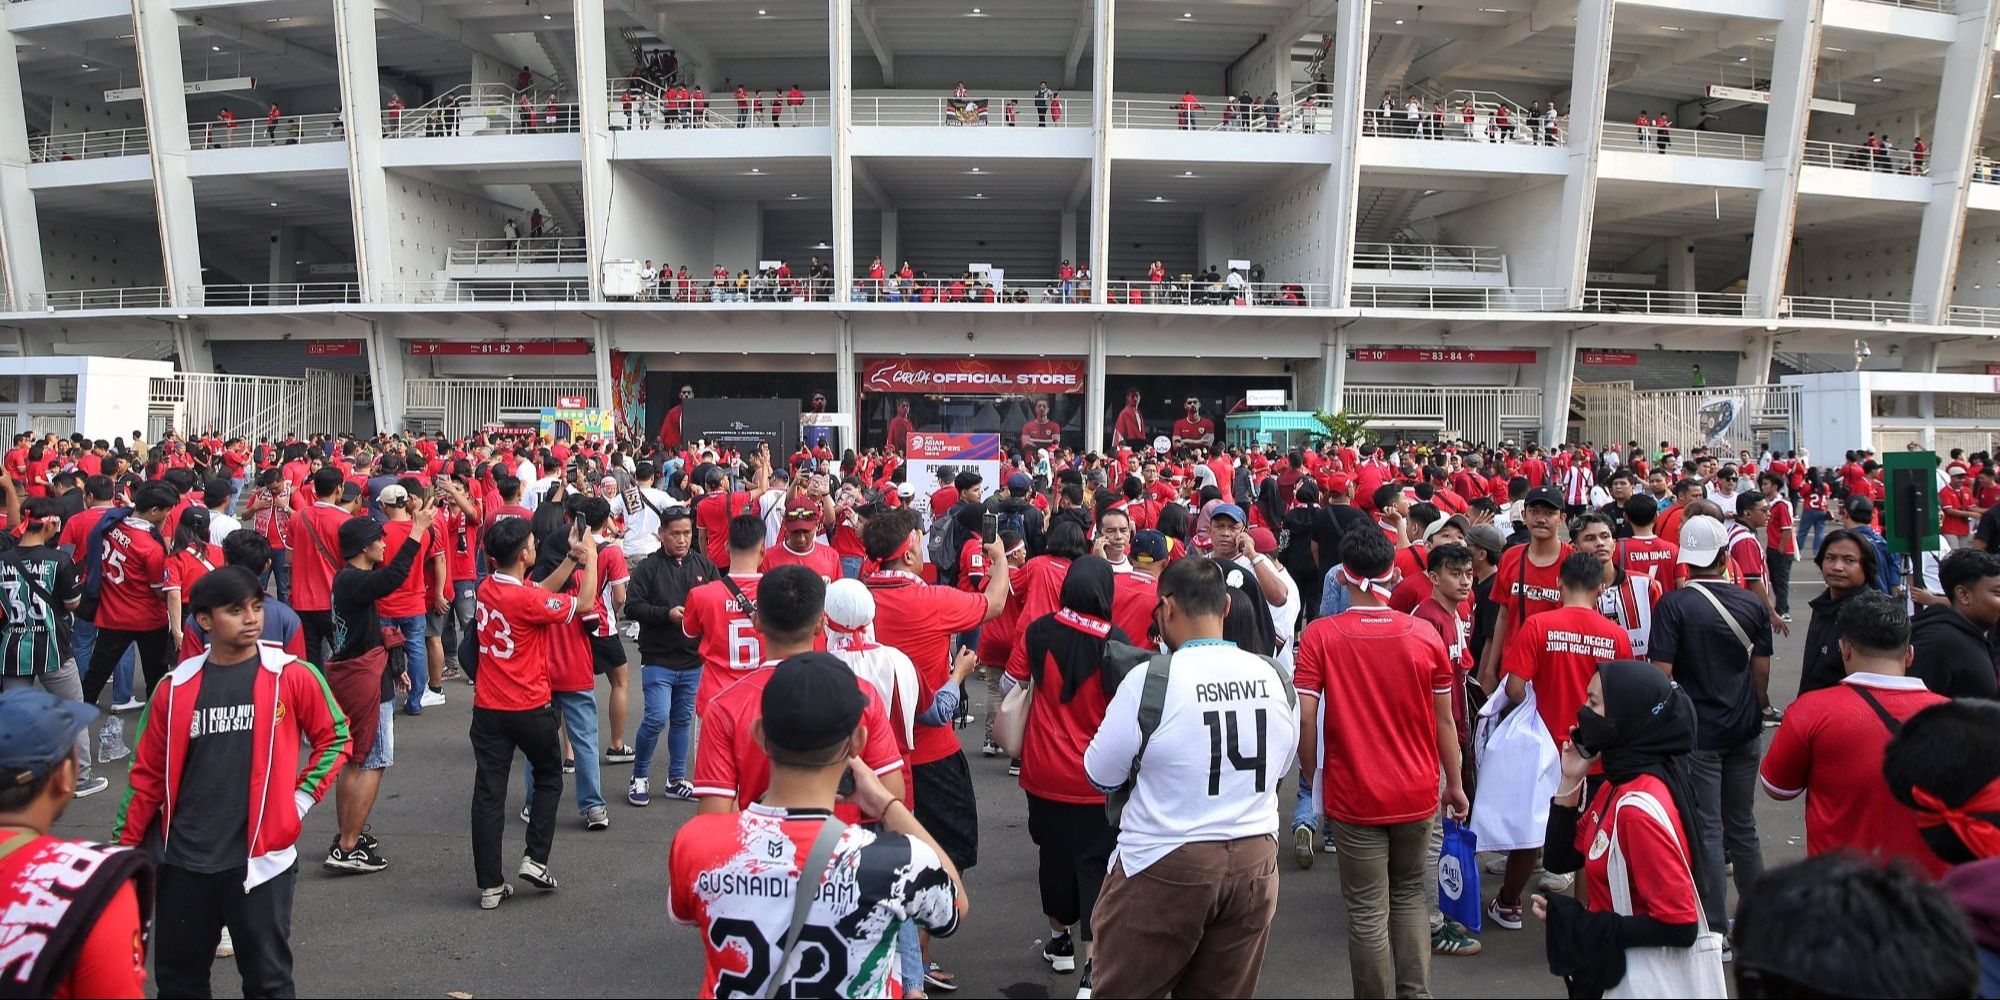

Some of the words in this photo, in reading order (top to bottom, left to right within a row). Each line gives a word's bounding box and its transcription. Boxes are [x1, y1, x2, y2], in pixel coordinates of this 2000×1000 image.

[482, 344, 492, 353] 81
[500, 344, 511, 353] 82
[1432, 352, 1443, 360] 83
[1450, 352, 1462, 360] 84
[892, 370, 931, 385] GARUDA
[933, 373, 1012, 384] OFFICIAL
[1017, 373, 1076, 384] STORE
[1630, 551, 1649, 562] EVAN
[1649, 550, 1672, 560] DIMAS
[728, 618, 760, 670] 6
[1547, 630, 1582, 643] BAGIMU
[1583, 635, 1615, 649] NEGERI
[1546, 641, 1568, 652] JIWA
[1592, 647, 1616, 660] KAMI
[1195, 679, 1270, 703] ASNAWI
[209, 706, 236, 721] KULO
[209, 719, 231, 734] LIGA
[232, 717, 254, 731] SIJI
[1203, 708, 1267, 796] 14
[699, 872, 788, 898] GUSNAIDI
[797, 881, 854, 904] AM
